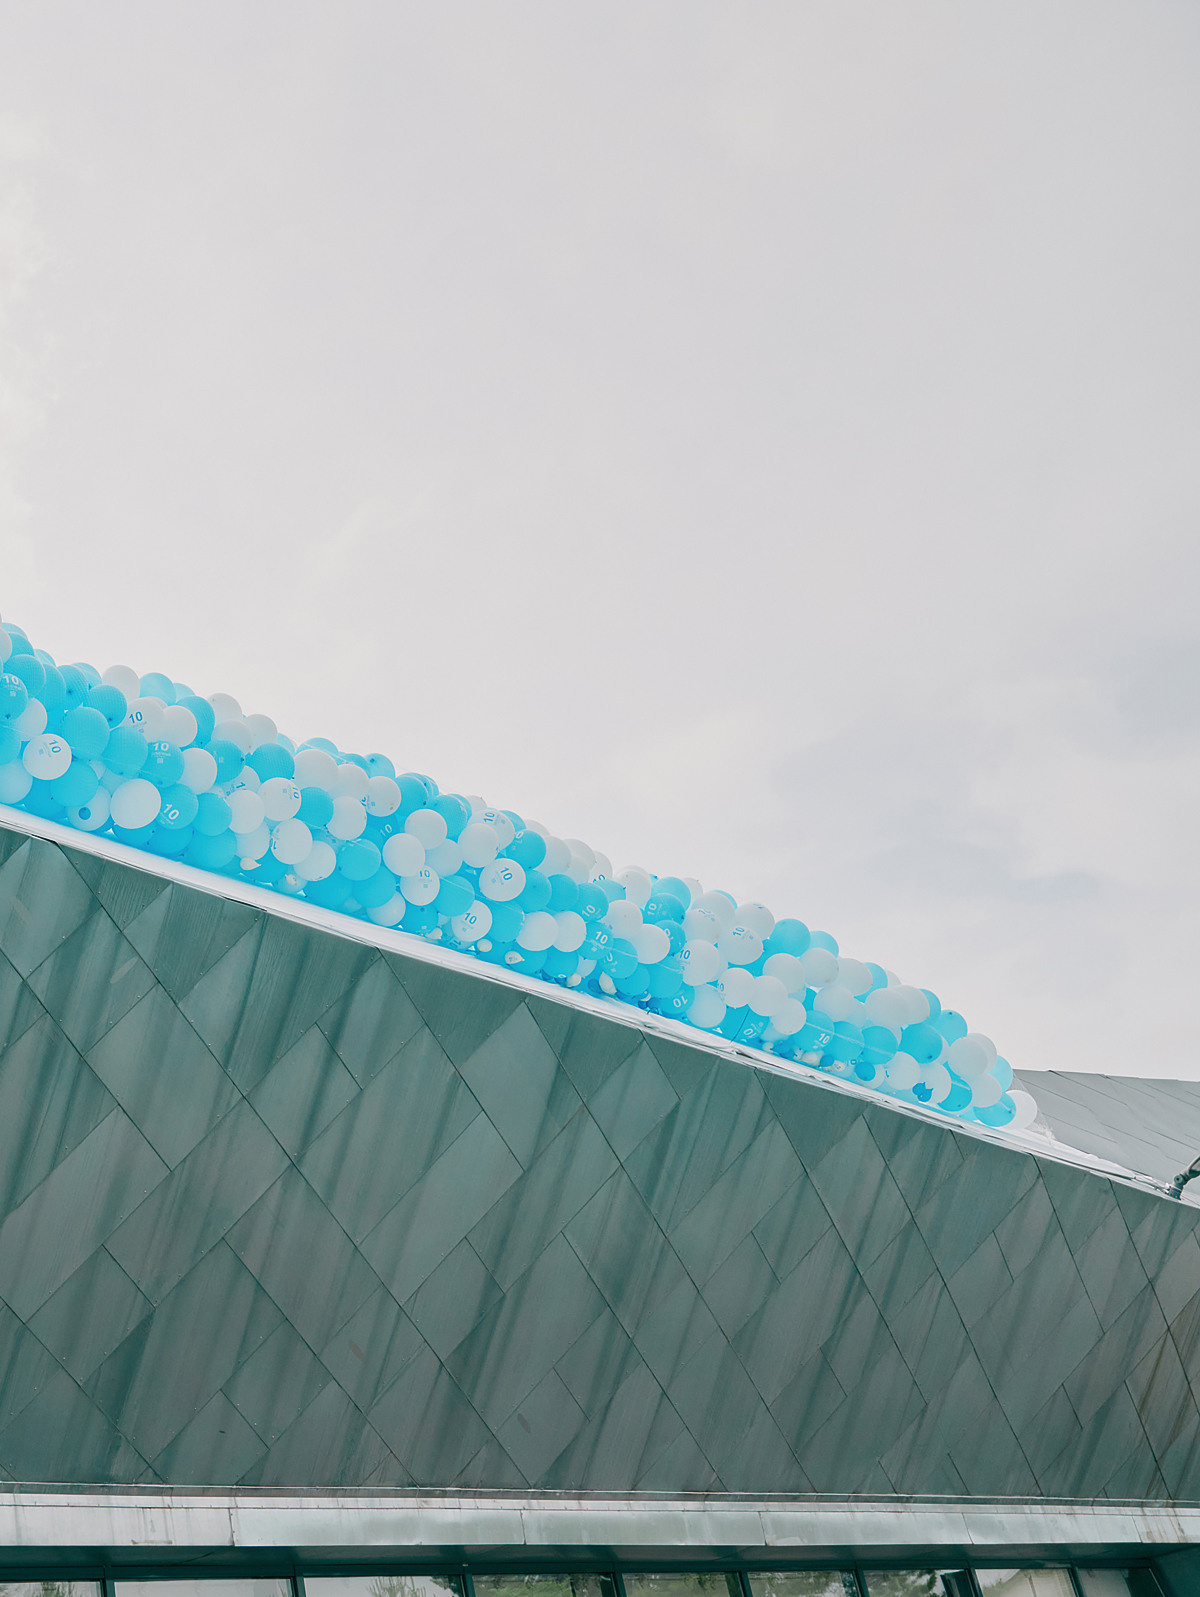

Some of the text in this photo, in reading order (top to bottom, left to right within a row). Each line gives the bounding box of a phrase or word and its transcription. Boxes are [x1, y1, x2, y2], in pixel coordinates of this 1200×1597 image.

[3, 675, 19, 685] 10
[129, 712, 143, 724] 10
[49, 740, 62, 754] 10
[153, 742, 170, 751] 10
[163, 804, 180, 820] 10
[484, 812, 495, 823] 10
[380, 824, 392, 837] 10
[420, 870, 430, 878] 10
[500, 867, 512, 881] 10
[582, 904, 596, 918] 10
[648, 904, 657, 916] 10
[464, 913, 477, 924] 10
[733, 927, 744, 936] 10
[595, 932, 608, 944] 10
[679, 950, 690, 960] 10
[673, 996, 688, 1008] 10
[818, 1033, 830, 1044] 10
